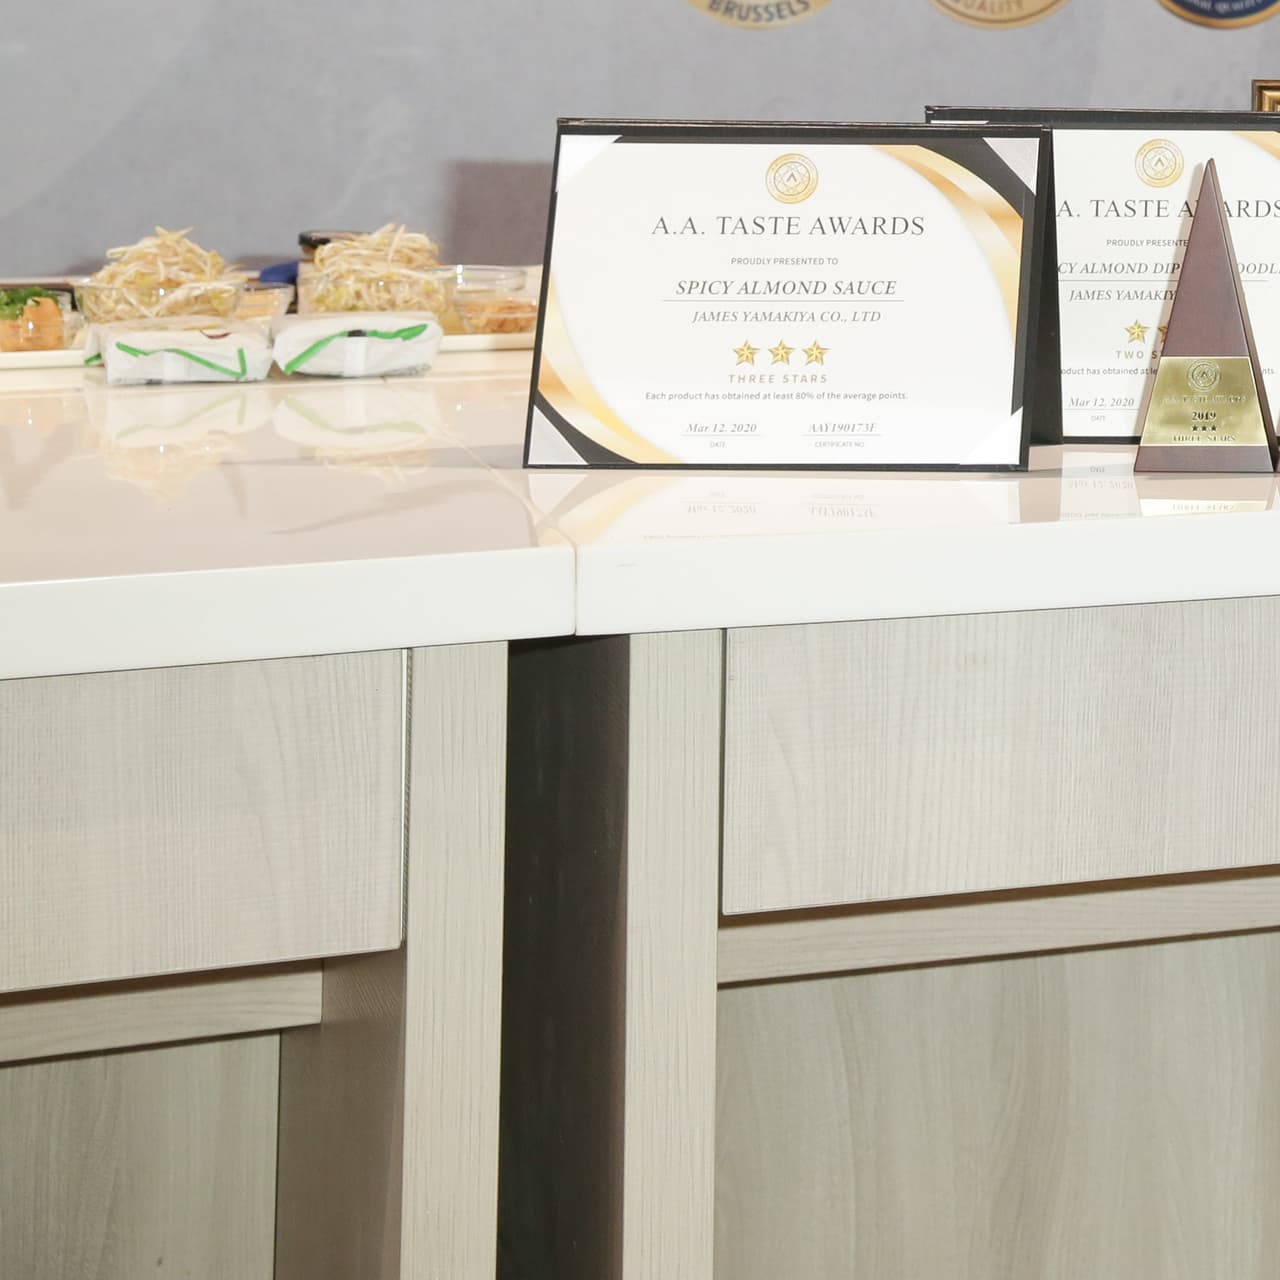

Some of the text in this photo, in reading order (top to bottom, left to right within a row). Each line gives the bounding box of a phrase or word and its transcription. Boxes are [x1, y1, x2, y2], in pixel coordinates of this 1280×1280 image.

[1056, 200, 1081, 218] A.
[1090, 200, 1169, 218] TASTE
[652, 216, 925, 235] A.A. TASTE AWARDS
[1146, 239, 1190, 247] PRESENTE
[731, 257, 839, 265] PROUDLY PRESENTED TO
[1080, 263, 1149, 275] ALMOND
[675, 280, 897, 295] SPICY ALMOND SAUCE
[1069, 290, 1177, 302] JAMES YAMAKIY
[691, 311, 738, 324] JAMES
[743, 311, 815, 322] YAMAKIYA
[851, 311, 881, 322] LTD
[1115, 350, 1144, 359] TWO
[1060, 367, 1084, 375] oduct
[1087, 367, 1100, 375] has
[1102, 367, 1138, 375] obtained
[729, 374, 828, 384] THREE STARS
[645, 392, 909, 402] Each product has obtained at least 80% of the average points.
[1068, 398, 1089, 407] Mar
[1110, 398, 1135, 407] 2020
[1192, 412, 1216, 420] 2019
[686, 423, 709, 433] Mar
[730, 423, 757, 433] 2020
